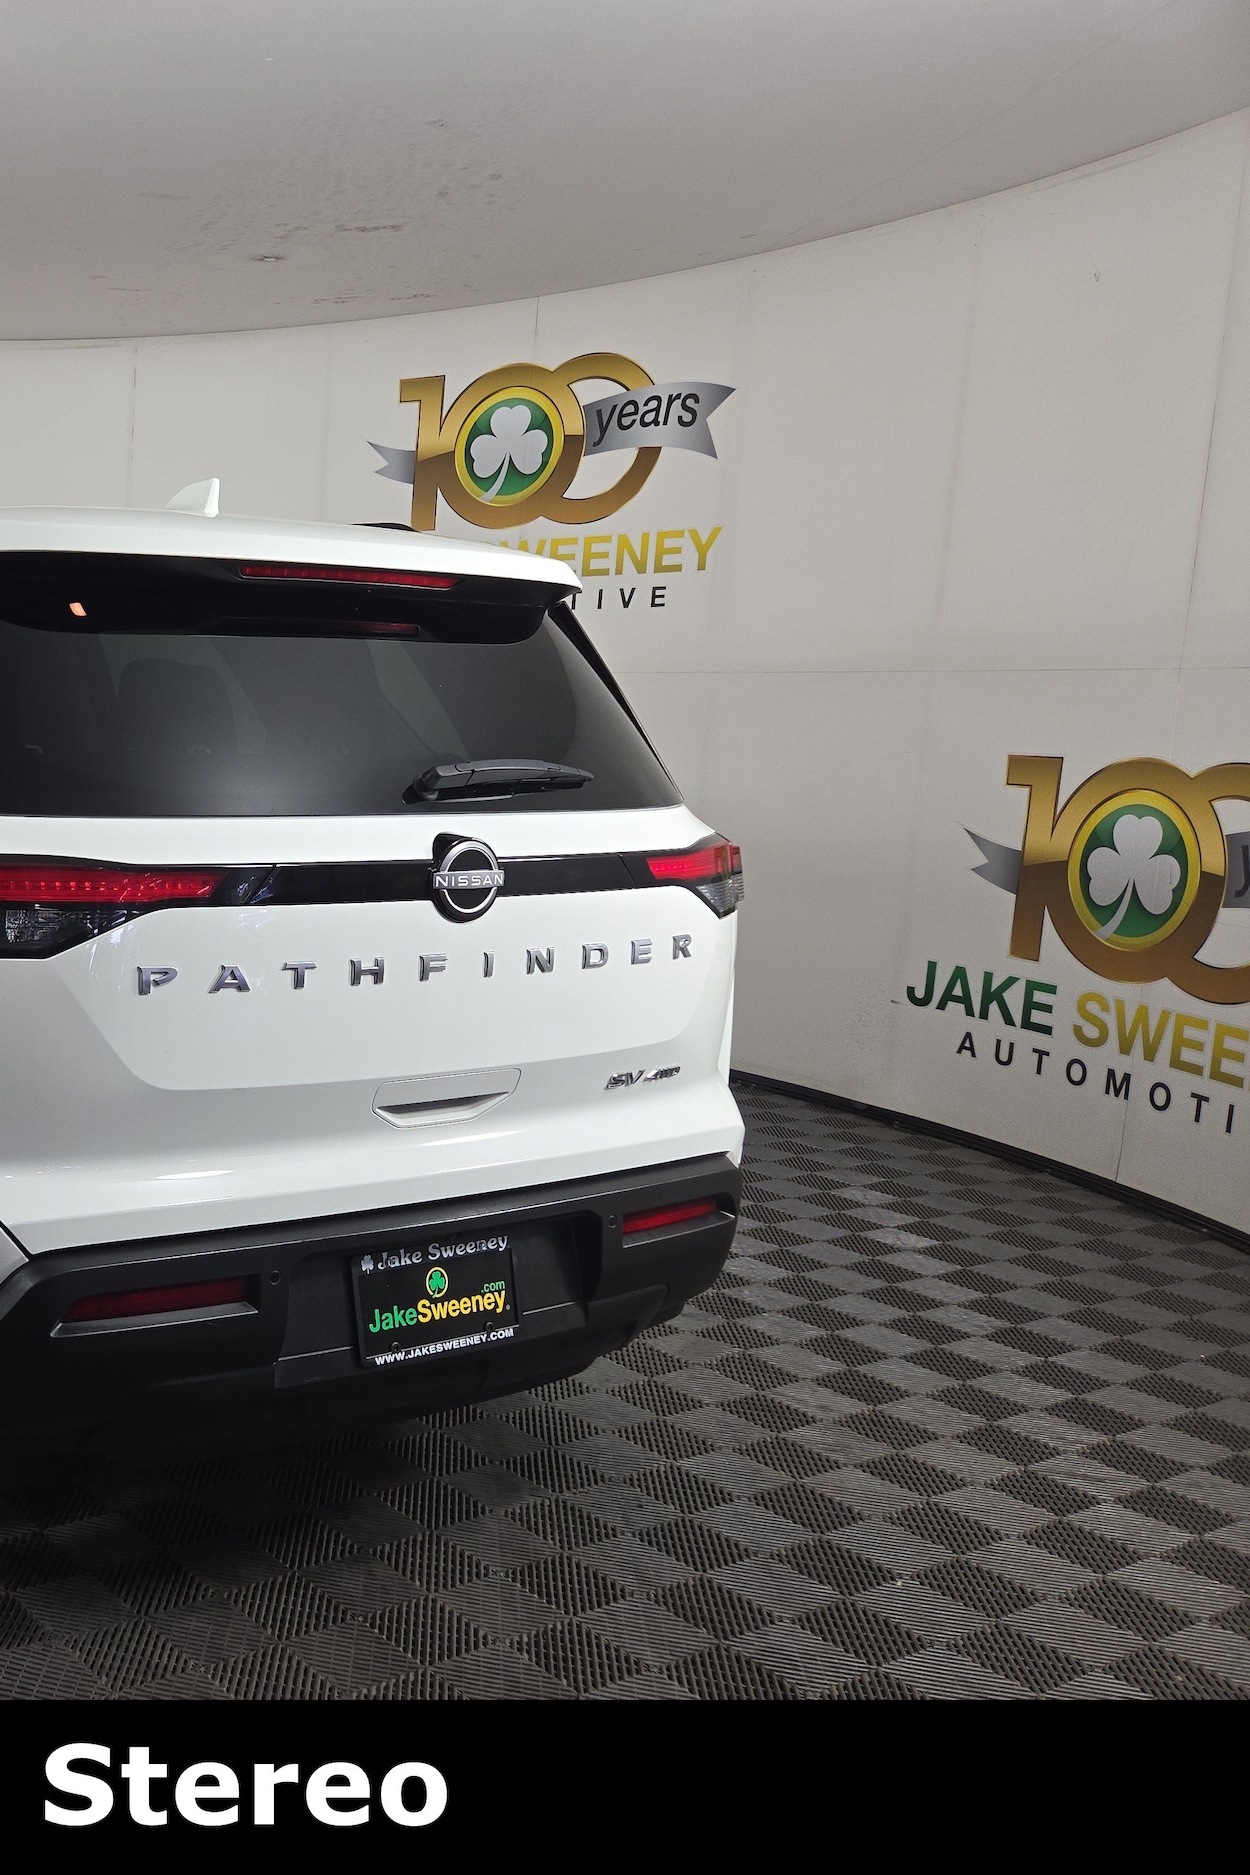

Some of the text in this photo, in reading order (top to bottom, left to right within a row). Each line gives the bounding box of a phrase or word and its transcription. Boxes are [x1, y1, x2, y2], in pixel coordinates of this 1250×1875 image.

[399, 352, 663, 530] 100
[593, 393, 700, 447] years
[435, 873, 503, 888] NISSAN
[137, 934, 693, 996] PATHFINDER
[907, 960, 1250, 1090] JAKE SWEE
[604, 1069, 646, 1090] SV
[957, 1031, 1236, 1134] AUTOMOTI
[378, 1235, 509, 1270] Jake Sweeney
[481, 1280, 506, 1293] .com
[375, 1328, 515, 1365] WWW.JAKESWEENEY.COM
